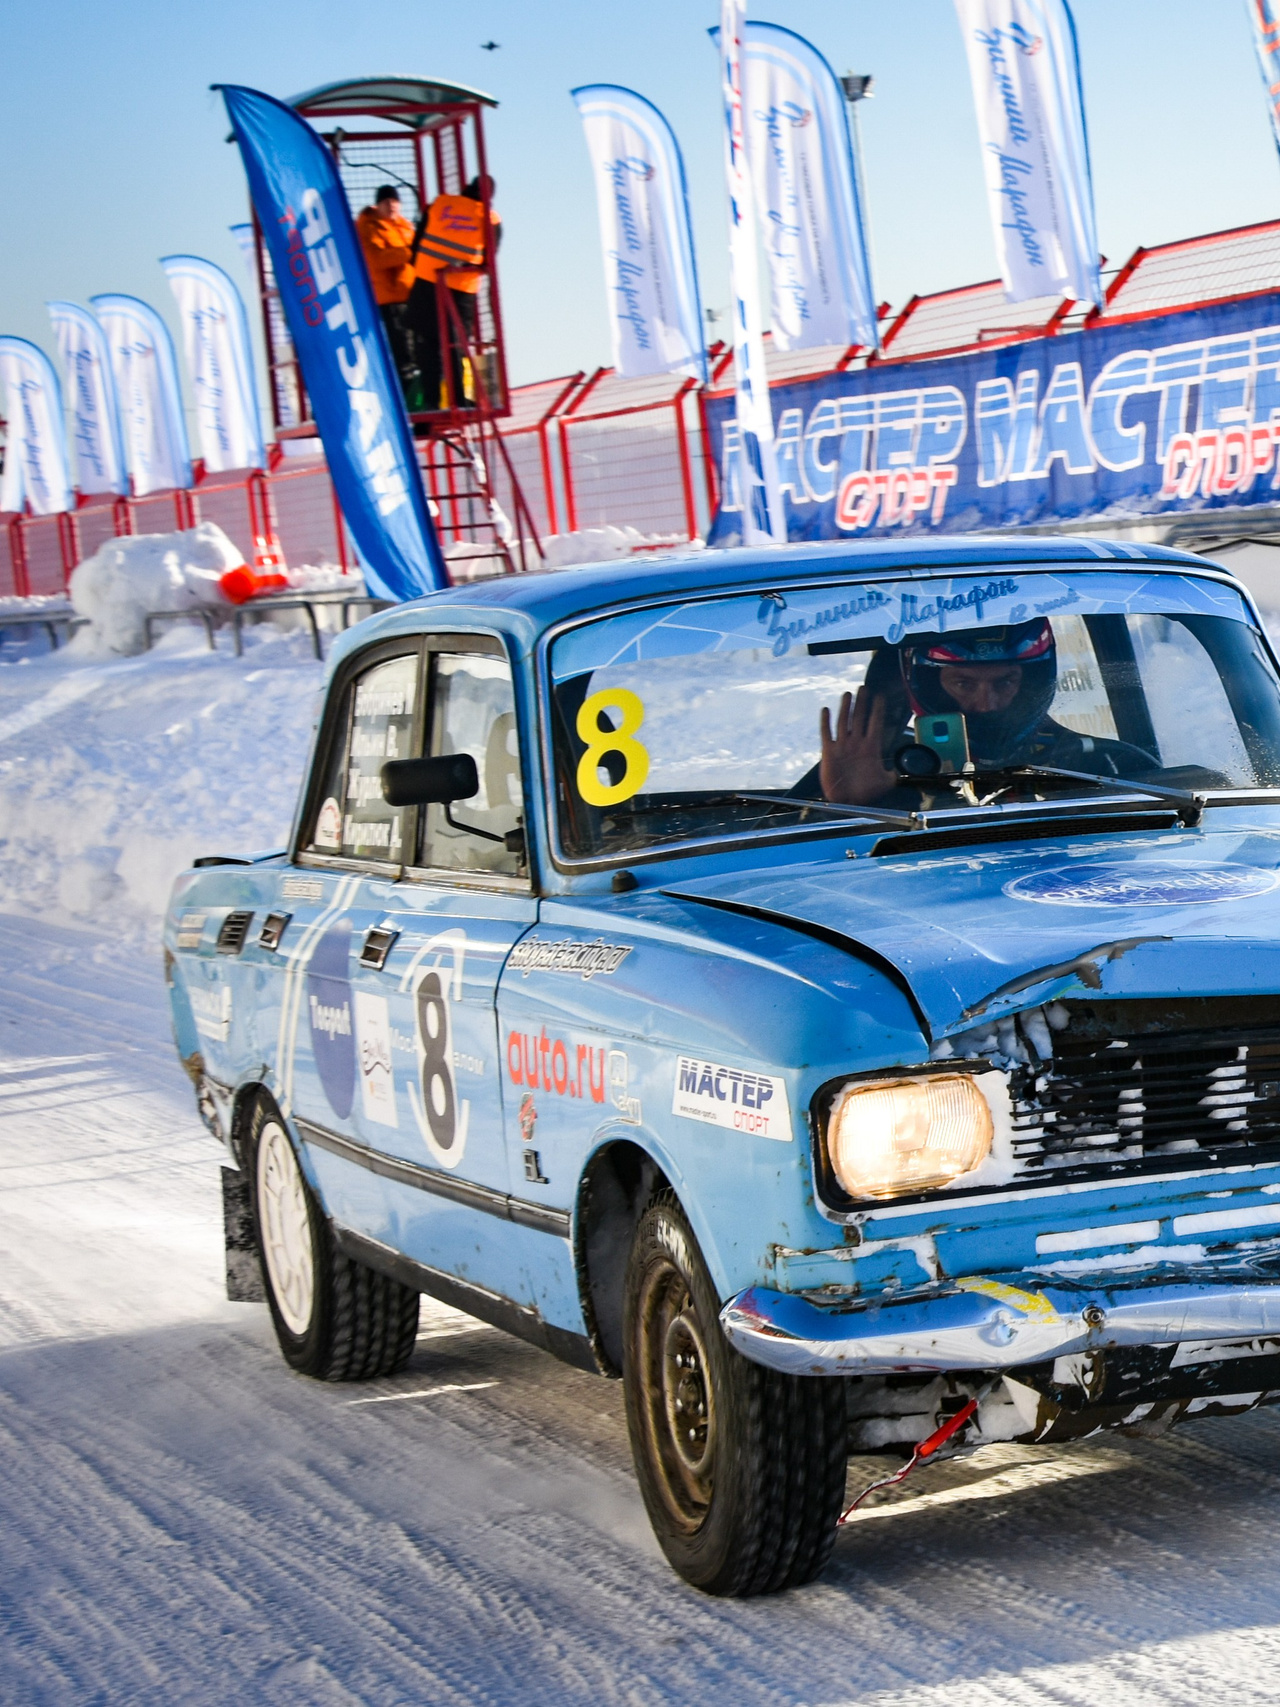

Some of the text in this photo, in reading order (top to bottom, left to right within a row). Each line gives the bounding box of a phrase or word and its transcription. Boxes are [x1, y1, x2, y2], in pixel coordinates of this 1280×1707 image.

[986, 142, 1043, 267] Марафон
[609, 250, 652, 350] Марафон
[836, 465, 958, 530] СПОРТ
[757, 579, 1018, 657] Зимний Марафон
[576, 688, 649, 807] 8
[1042, 874, 1273, 900] ОДНА ТОННА
[417, 972, 456, 1150] 8
[507, 1025, 605, 1103] auto.ru
[678, 1059, 773, 1110] МАСТЕР
[733, 1110, 770, 1135] СПОРТ
